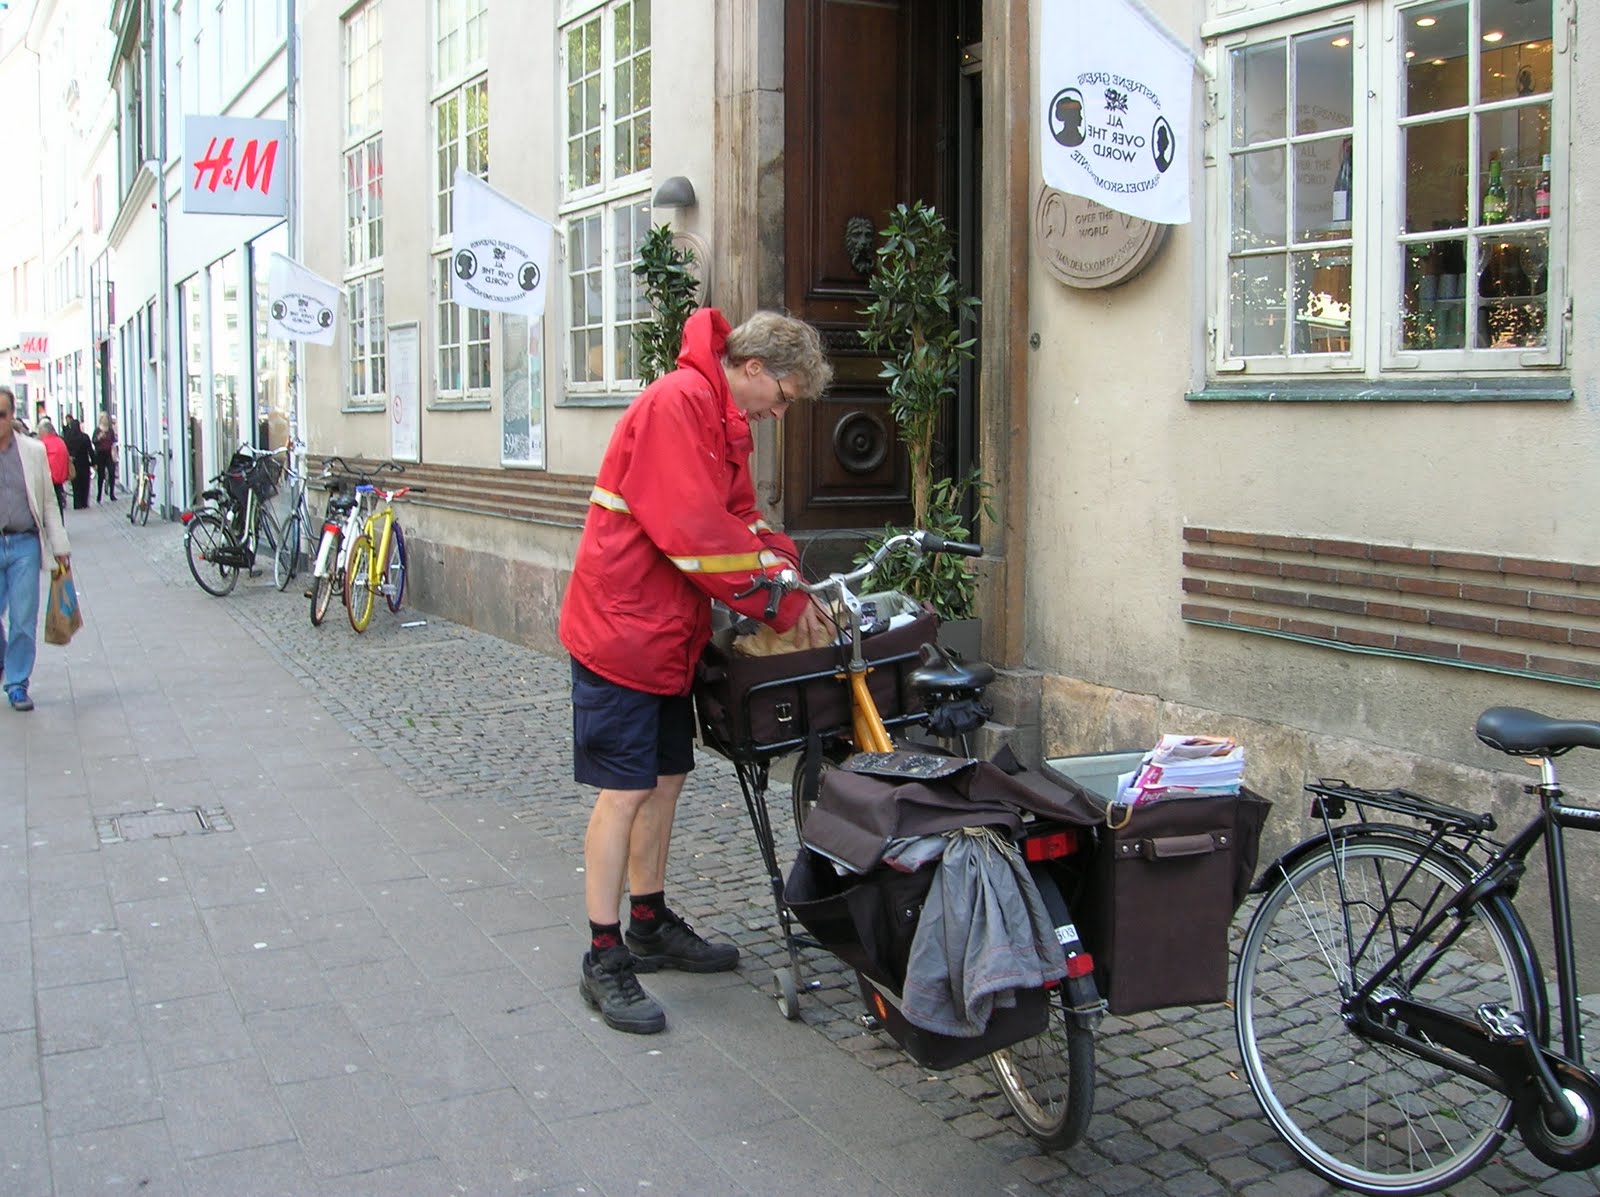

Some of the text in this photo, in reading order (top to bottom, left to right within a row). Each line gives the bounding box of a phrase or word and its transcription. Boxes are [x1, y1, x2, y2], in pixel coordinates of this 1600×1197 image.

[193, 136, 278, 195] H&M
[1098, 209, 1114, 220] THE
[1079, 225, 1109, 238] WORLD
